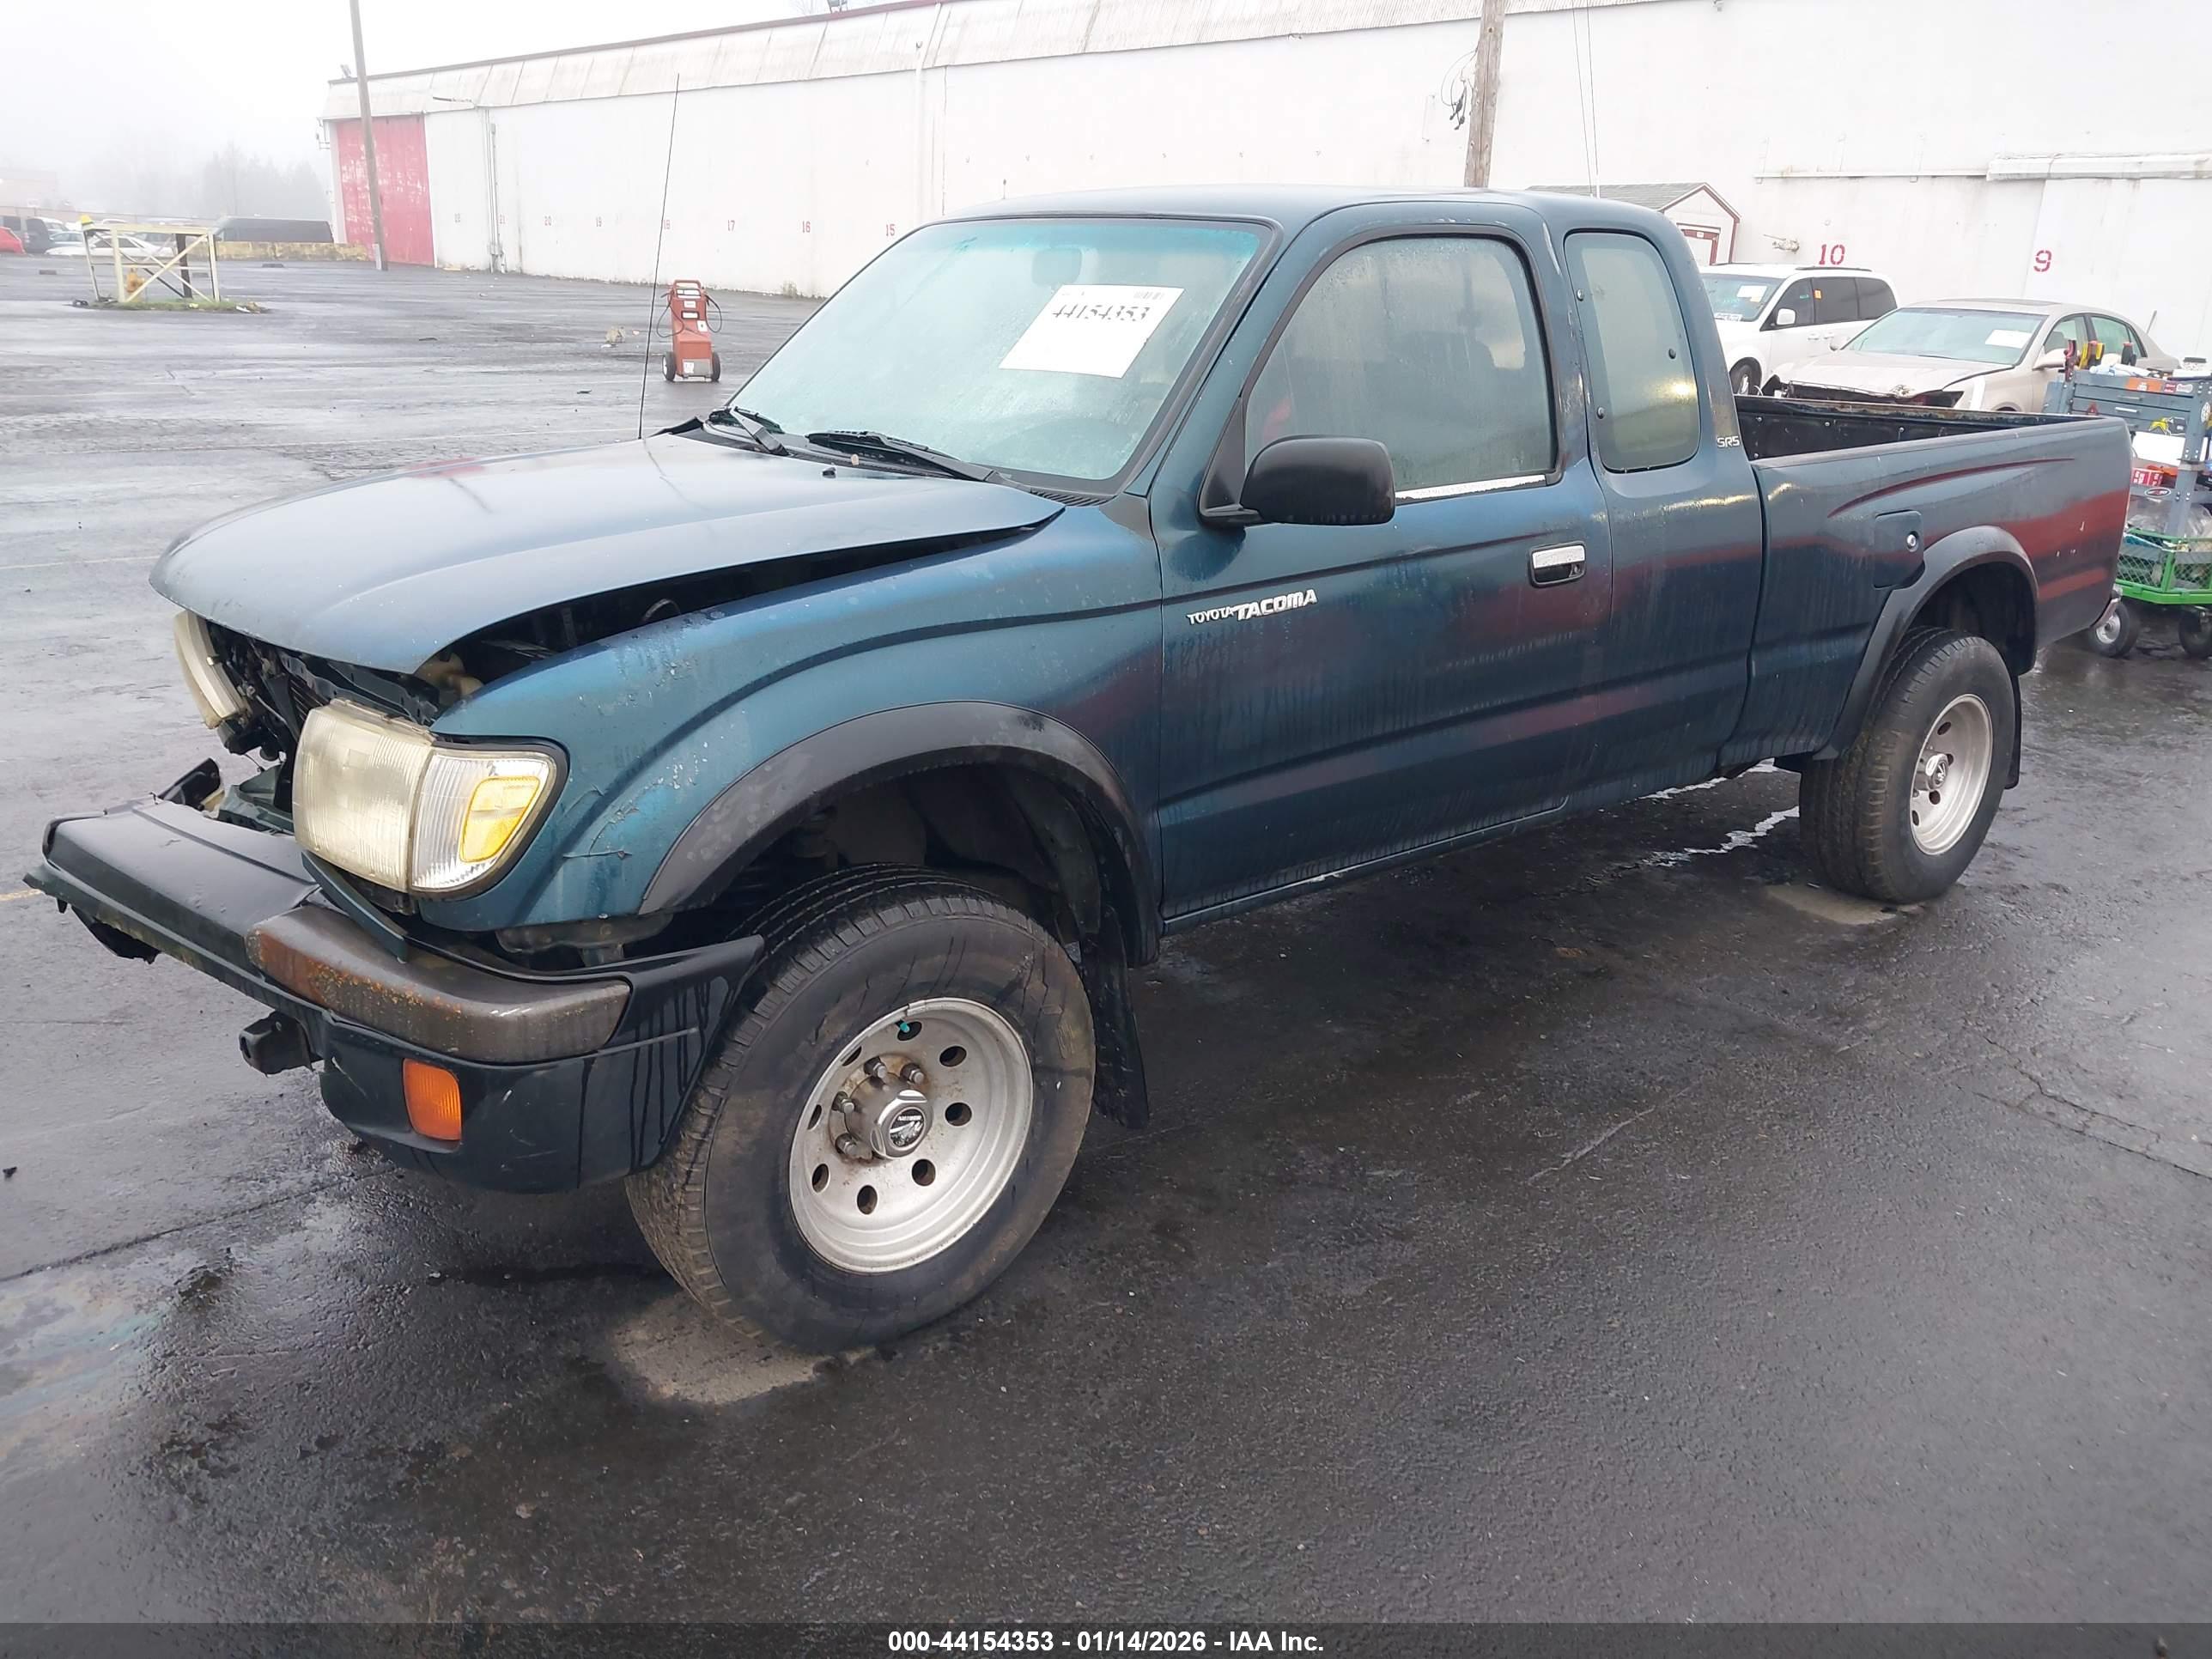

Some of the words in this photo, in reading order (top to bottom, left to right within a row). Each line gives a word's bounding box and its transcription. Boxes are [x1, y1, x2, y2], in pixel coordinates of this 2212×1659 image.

[544, 215, 552, 227] 20
[595, 216, 603, 228] 19
[663, 219, 671, 230] 18
[727, 219, 736, 232] 17
[801, 221, 811, 234] 16
[885, 223, 896, 237] 15
[1818, 244, 1845, 266] 10
[2033, 250, 2052, 273] 9
[1717, 435, 1741, 448] SR5
[1186, 605, 1234, 625] TOYOTA
[1234, 589, 1318, 622] TACOMA
